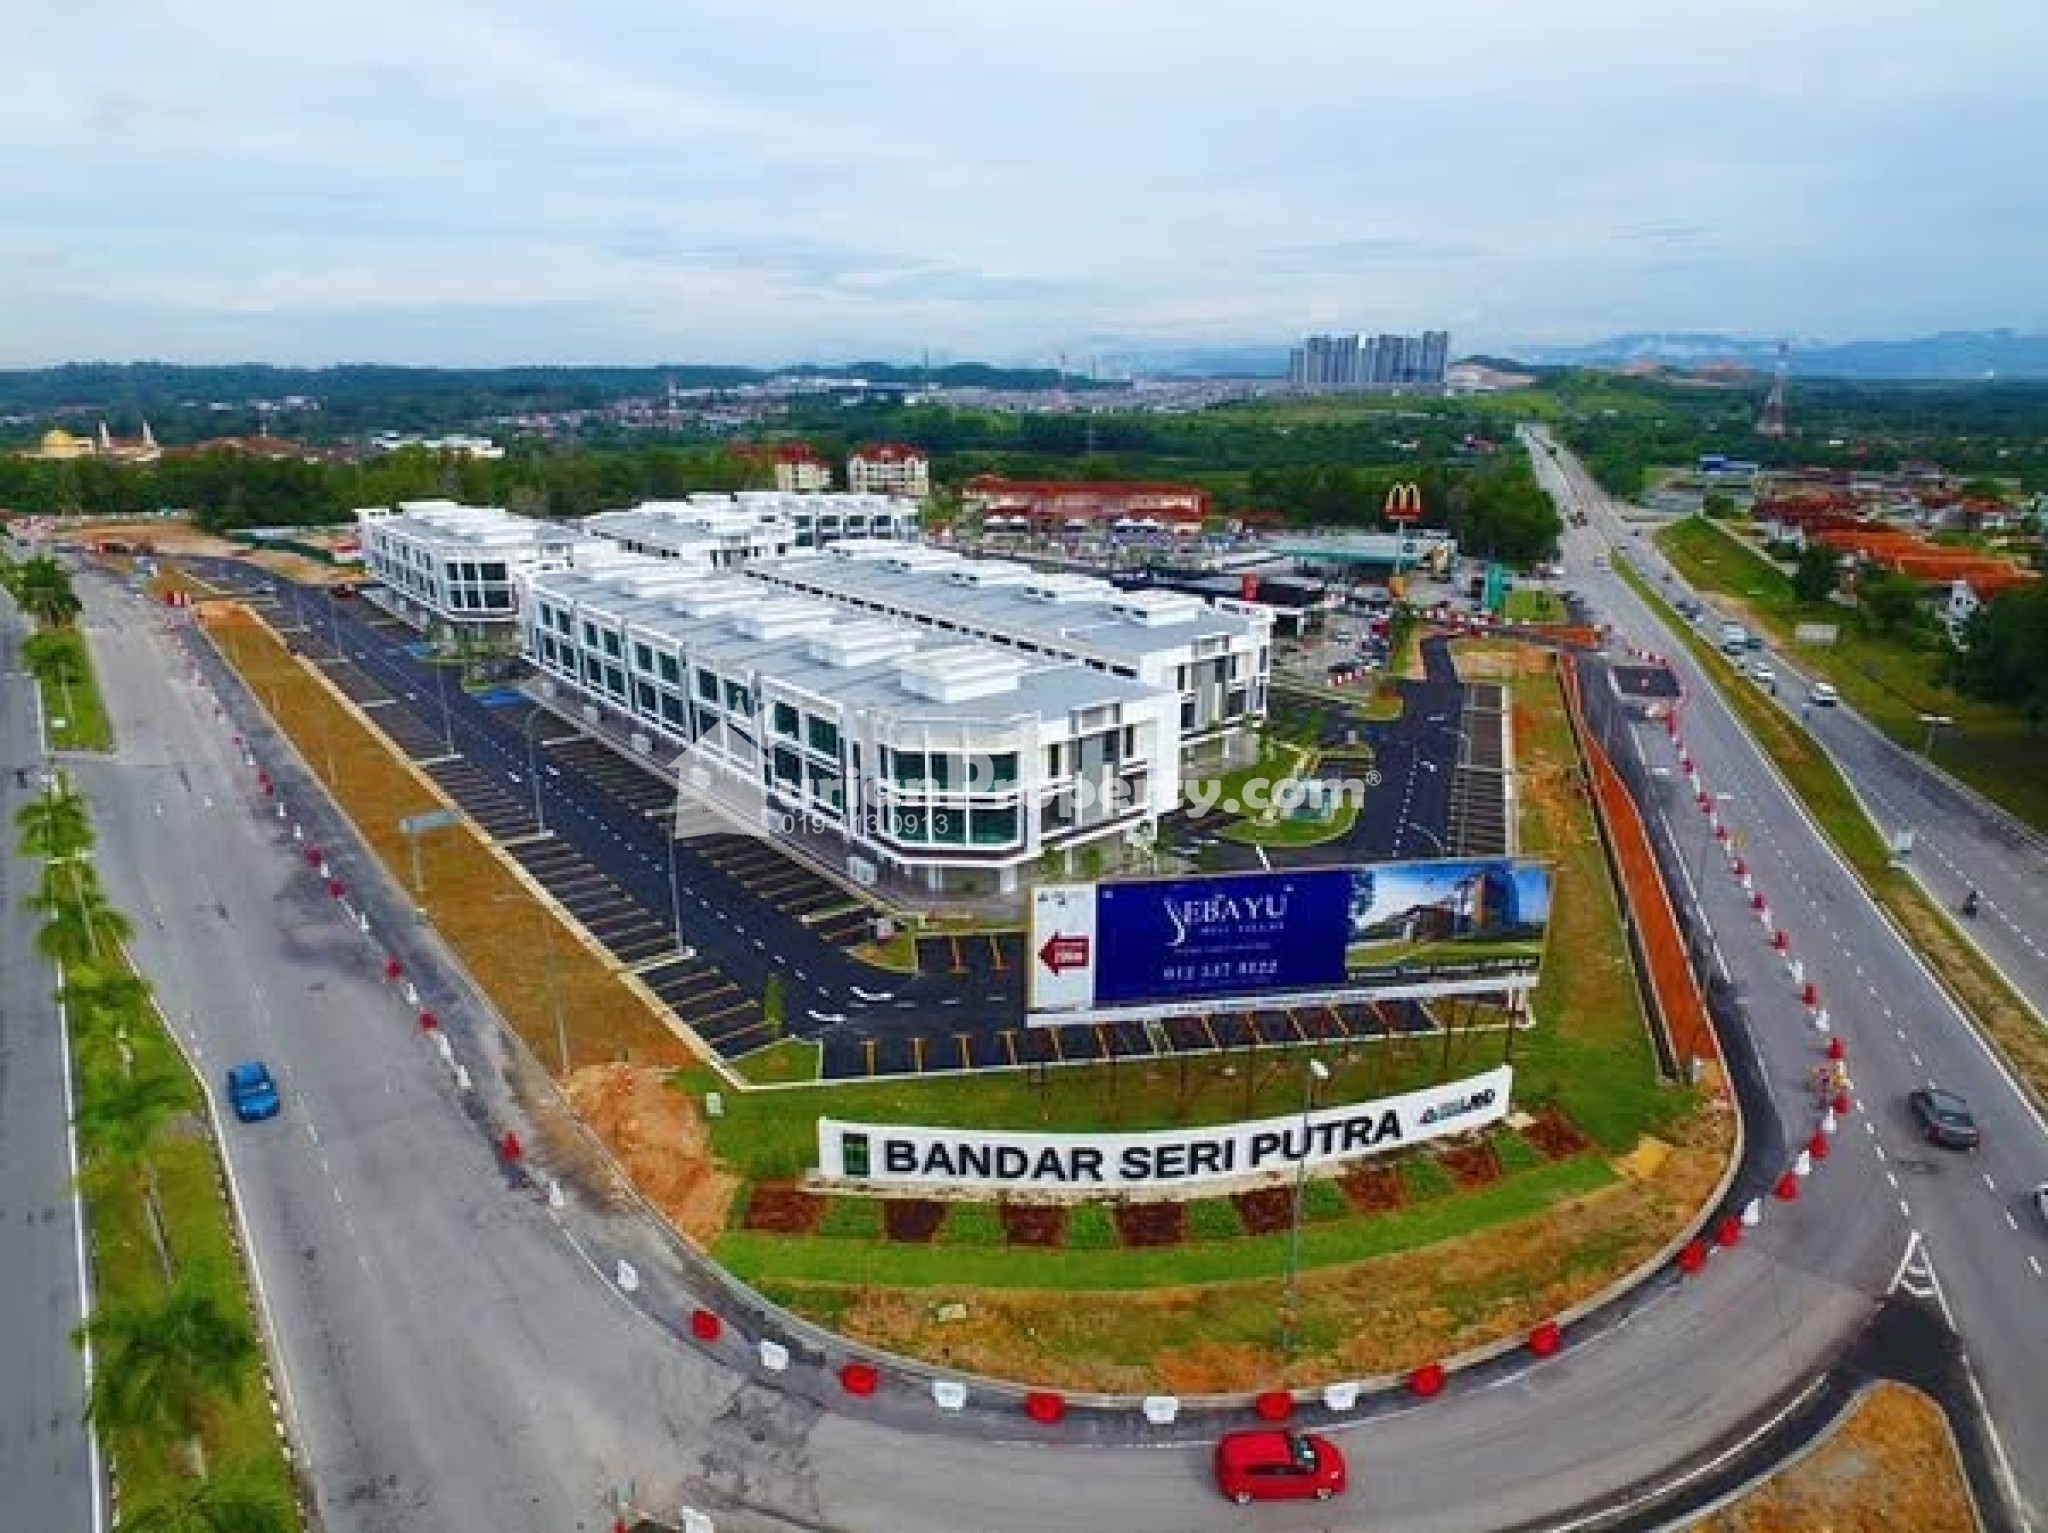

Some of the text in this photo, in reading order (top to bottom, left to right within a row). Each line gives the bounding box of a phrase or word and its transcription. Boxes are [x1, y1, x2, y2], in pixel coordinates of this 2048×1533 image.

[884, 1139, 1104, 1182] BANDAR
[1119, 1139, 1236, 1178] SERI
[1251, 1109, 1403, 1168] PUTRA
